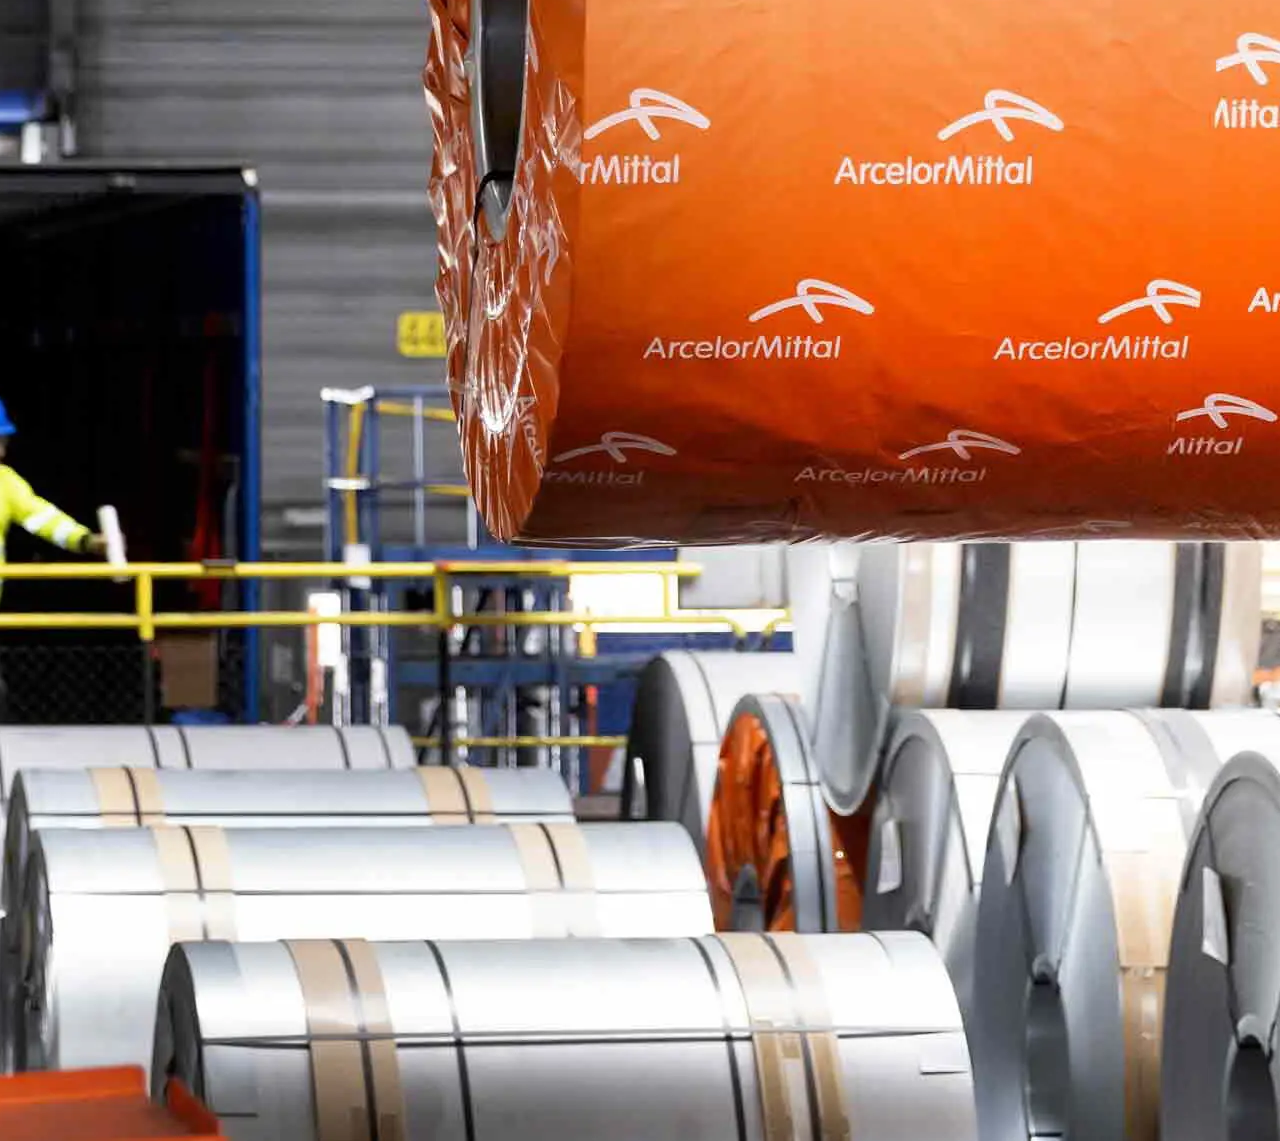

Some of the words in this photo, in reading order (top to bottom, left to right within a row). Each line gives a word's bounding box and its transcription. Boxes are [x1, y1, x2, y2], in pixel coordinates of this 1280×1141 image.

[578, 154, 679, 184] rMittal
[834, 155, 1032, 185] ArcelorMittal
[643, 336, 841, 359] ArcelorMittal
[994, 336, 1189, 360] ArcelorMittal
[795, 467, 986, 484] ArcelorMittal
